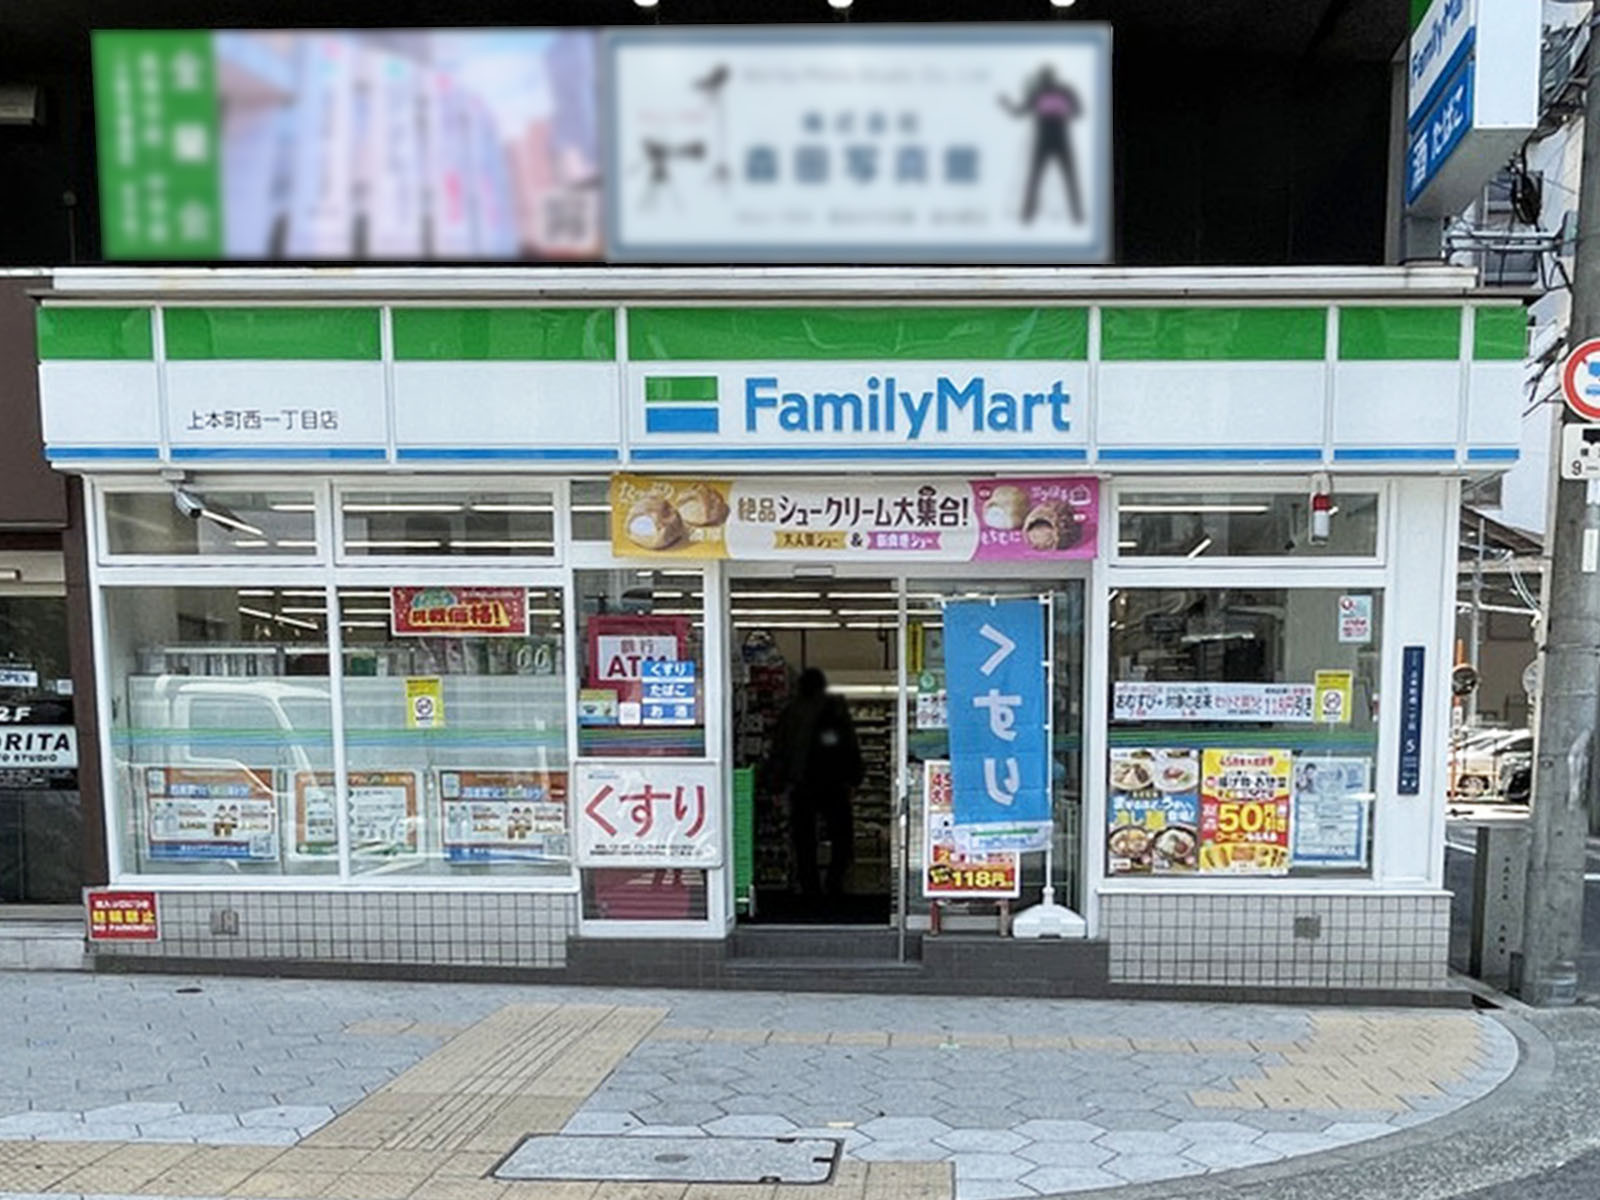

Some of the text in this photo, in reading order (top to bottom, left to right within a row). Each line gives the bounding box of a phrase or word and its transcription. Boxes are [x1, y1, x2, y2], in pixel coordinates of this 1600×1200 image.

[745, 376, 1070, 440] FamilyMart
[186, 409, 339, 431] 上本町西一丁目店
[850, 532, 863, 547] &
[0, 733, 70, 751] RITA
[584, 784, 706, 838] くすり
